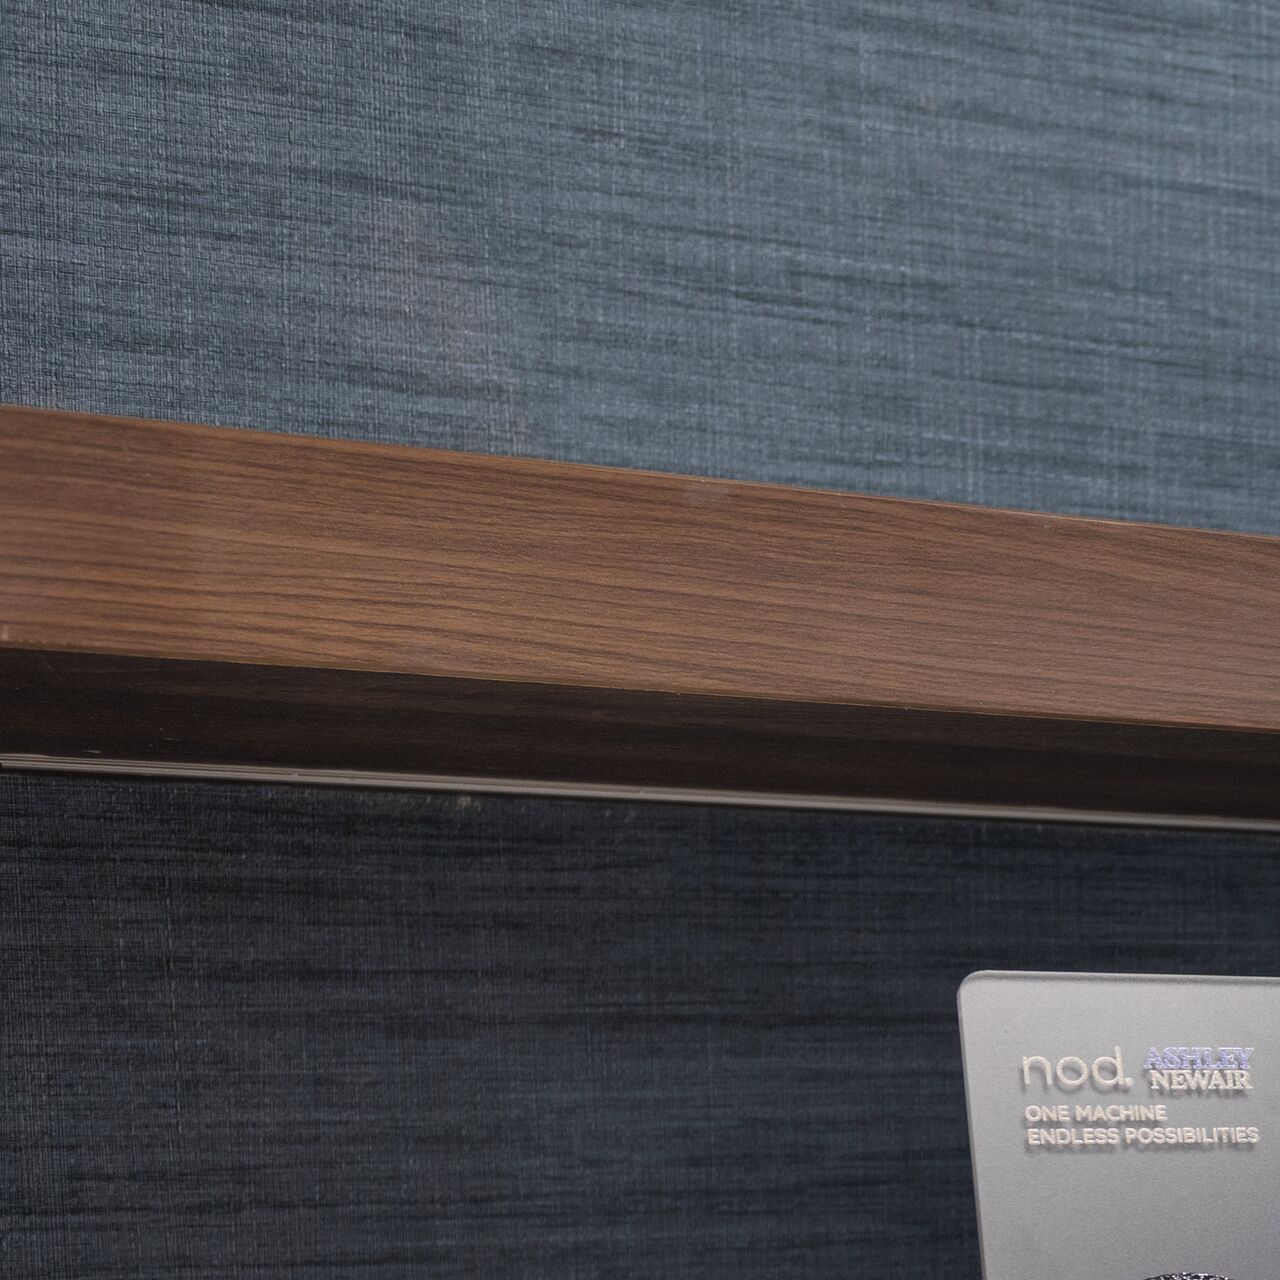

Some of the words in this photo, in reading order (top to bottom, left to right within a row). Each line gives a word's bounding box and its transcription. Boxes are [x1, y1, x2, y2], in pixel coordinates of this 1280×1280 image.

[1022, 1046, 1134, 1087] nod.
[1143, 1047, 1254, 1070] ASHLEY
[1150, 1069, 1253, 1090] NEWAIR
[1024, 1105, 1071, 1122] ONE
[1075, 1104, 1168, 1122] MACHINE
[1027, 1128, 1120, 1145] ENDLESS
[1125, 1127, 1260, 1144] POSSIBILITIES
